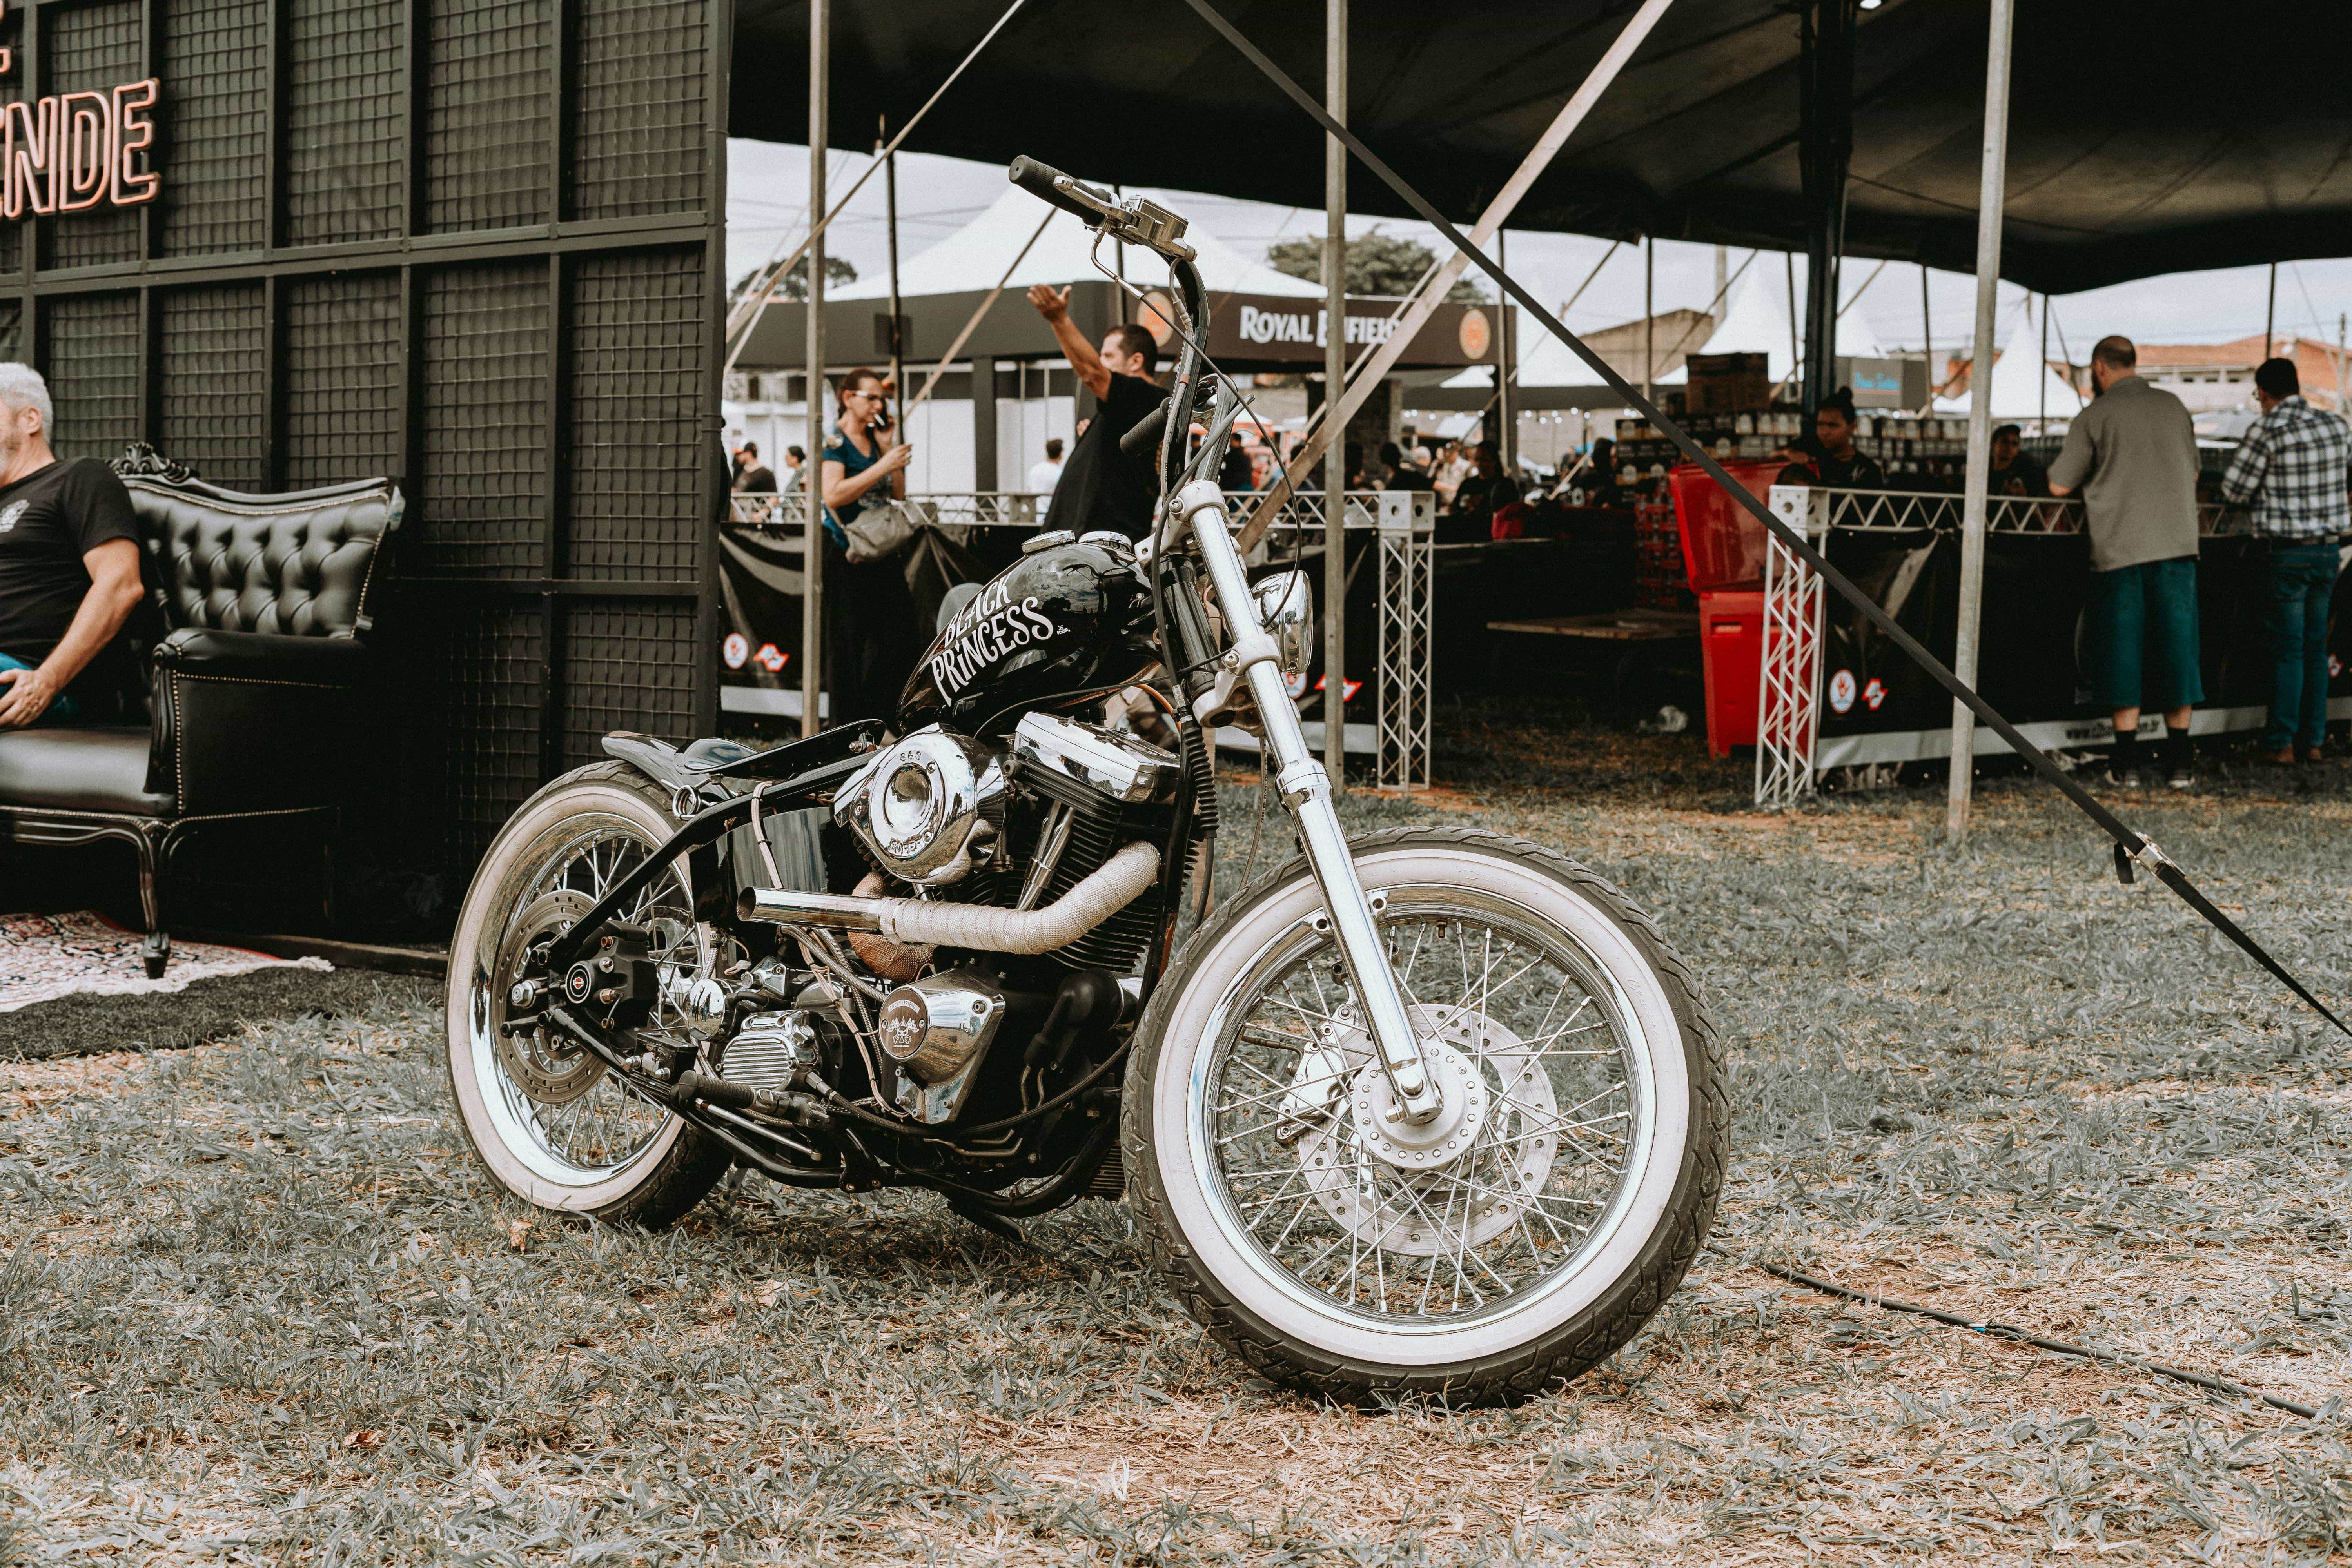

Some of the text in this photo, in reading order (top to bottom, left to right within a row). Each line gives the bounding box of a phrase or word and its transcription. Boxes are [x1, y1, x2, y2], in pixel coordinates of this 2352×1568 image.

[0, 79, 159, 218] NDE
[1240, 306, 1401, 347] ROYAL EFIELD
[944, 570, 1013, 648] BLACK
